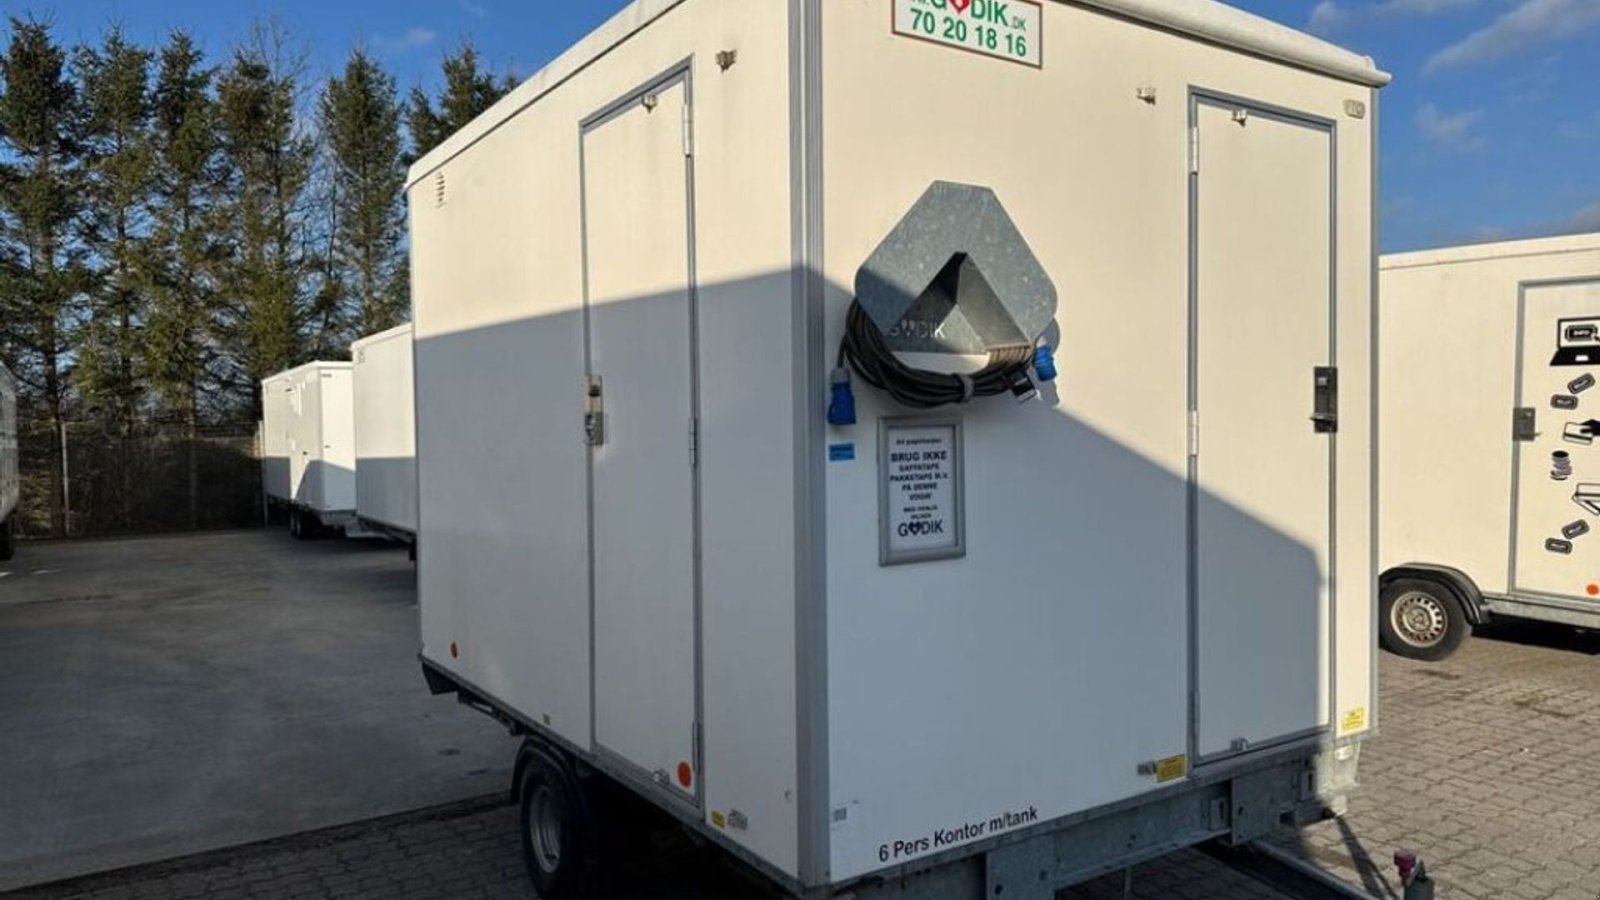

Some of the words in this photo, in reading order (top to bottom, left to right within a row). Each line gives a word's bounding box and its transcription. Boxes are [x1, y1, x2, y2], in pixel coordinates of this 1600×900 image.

[910, 8, 935, 34] 70
[943, 16, 967, 42] 20
[975, 25, 998, 50] 18
[1005, 33, 1027, 57] 16
[891, 451, 920, 462] BRUG
[923, 450, 947, 461] IKKE
[878, 844, 889, 862] 6
[893, 836, 930, 858] Pers
[934, 821, 985, 847] Kontor
[990, 806, 1038, 832] m/tank
